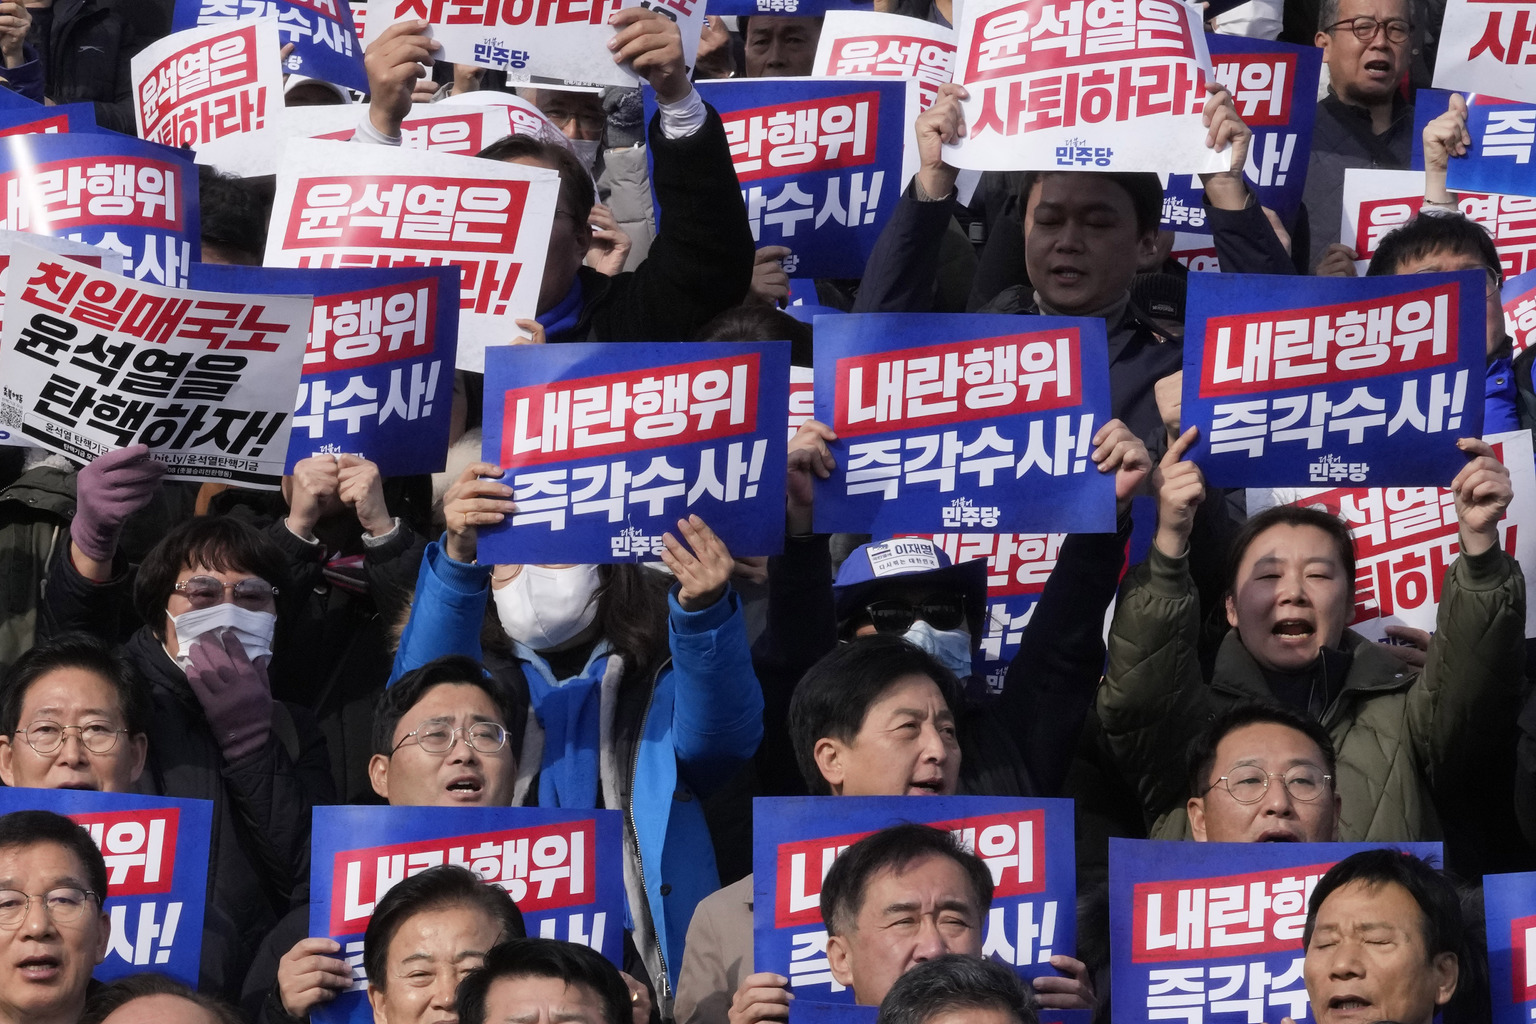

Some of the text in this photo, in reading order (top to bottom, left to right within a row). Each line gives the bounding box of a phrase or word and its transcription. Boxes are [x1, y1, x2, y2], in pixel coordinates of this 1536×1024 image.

[474, 43, 530, 69] 민주당
[836, 40, 955, 86] 윤석열
[976, 0, 1185, 71] 윤석열은
[142, 35, 247, 130] 윤석열은
[146, 87, 267, 148] 퇴하라!
[970, 63, 1206, 139] 사퇴하라!
[727, 101, 869, 173] 란행위
[1055, 145, 1114, 166] 민주당
[298, 181, 511, 243] 윤석열은
[1160, 204, 1207, 227] 민주당
[20, 262, 289, 352] 친일매국노
[1212, 295, 1450, 386] 내란행위
[14, 313, 247, 402] 윤석열을
[847, 337, 1072, 426] 내란행위
[33, 373, 288, 457] 탄핵하자!
[45, 422, 72, 442] 윤석열
[293, 361, 441, 438] 각수사!
[512, 365, 747, 457] 내란행위
[1208, 370, 1468, 458] 즉각수사!
[512, 440, 768, 532] 즉각수사!
[845, 413, 1095, 500] 즉각수사!
[1309, 461, 1369, 482] 민주당
[895, 542, 933, 556] 이재명
[942, 504, 999, 529] 민주당
